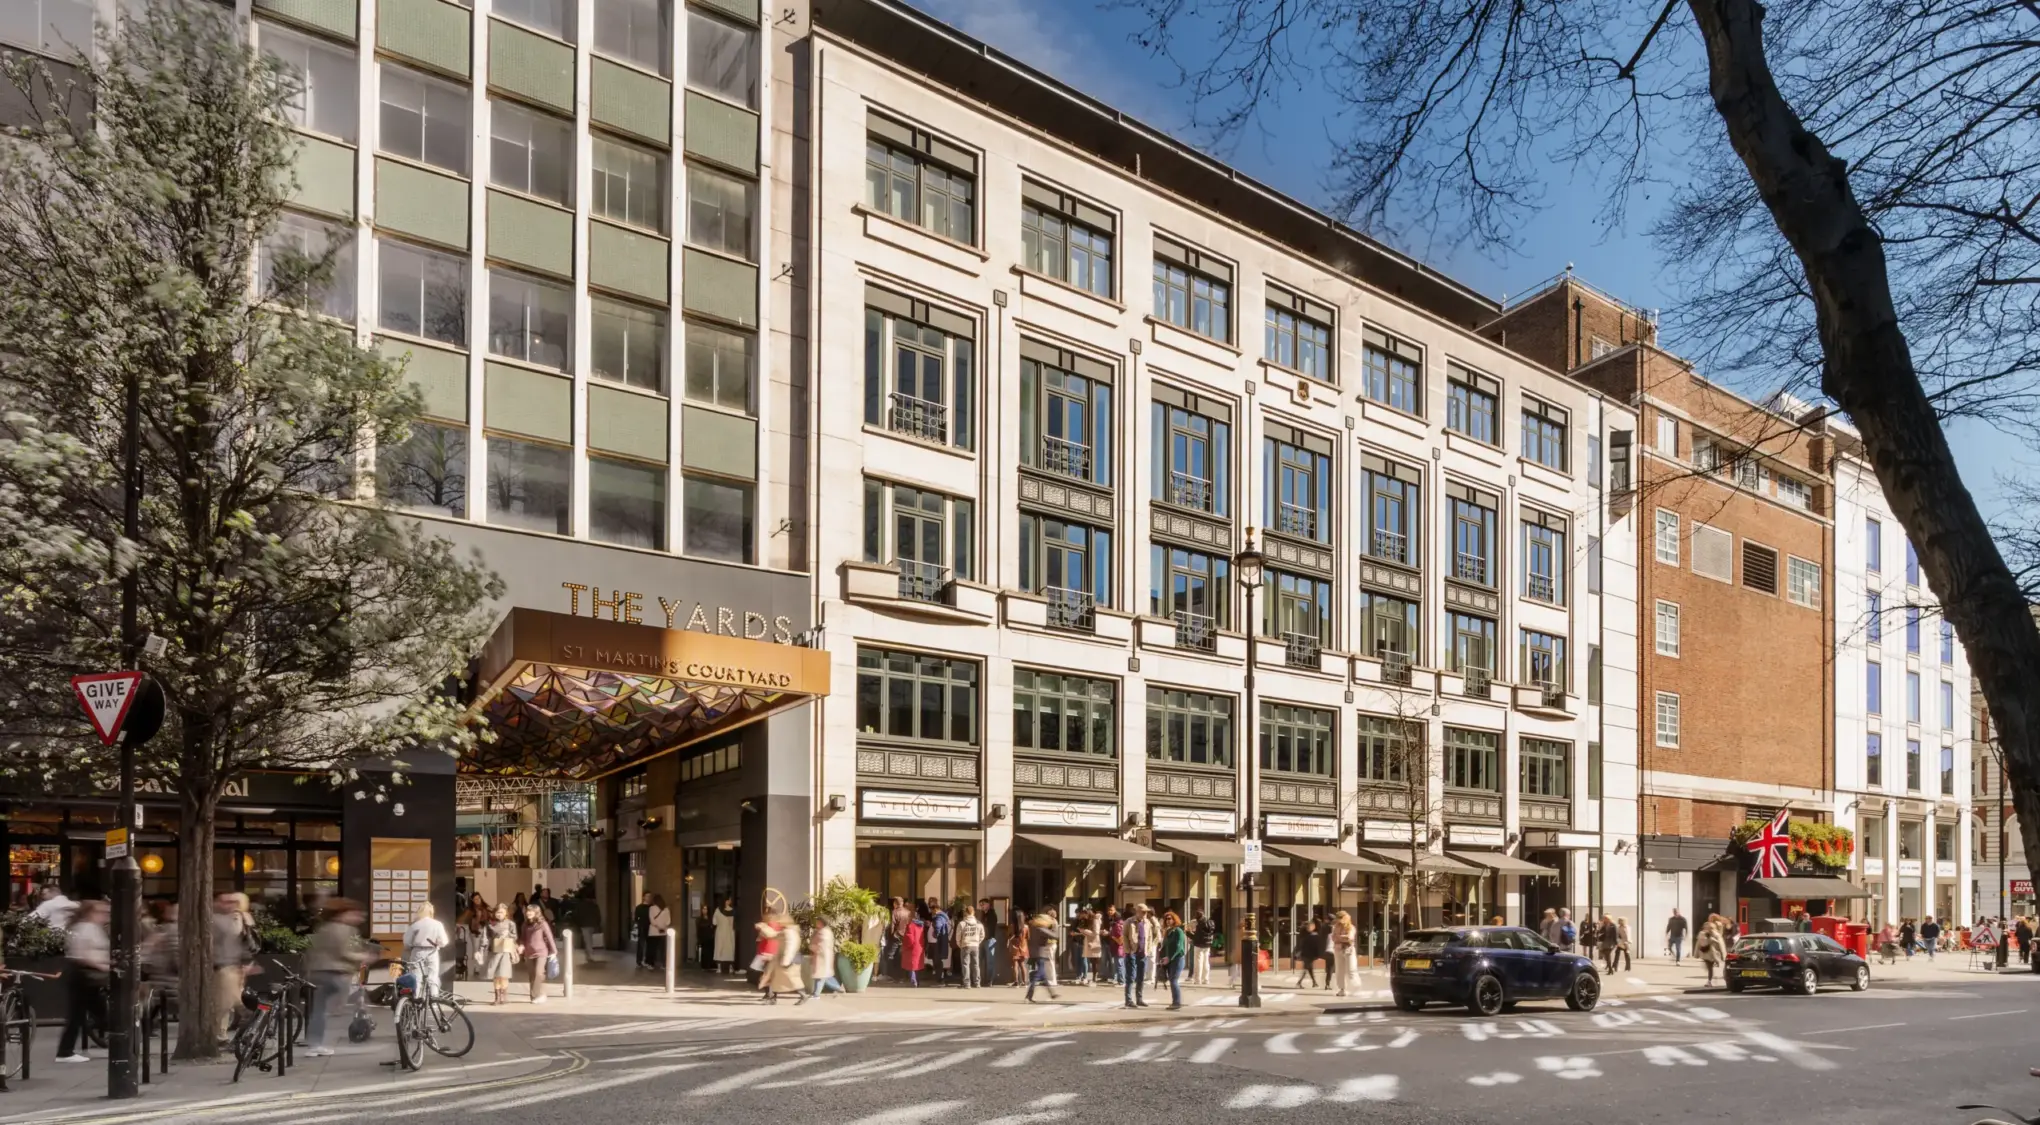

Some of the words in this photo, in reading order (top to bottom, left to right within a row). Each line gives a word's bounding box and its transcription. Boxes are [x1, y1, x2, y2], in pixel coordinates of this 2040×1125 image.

[562, 582, 643, 624] THE
[658, 596, 793, 647] YARDS
[563, 645, 584, 659] ST
[687, 664, 790, 688] COURTYARD
[86, 682, 125, 697] GIVE
[95, 698, 119, 709] WAY
